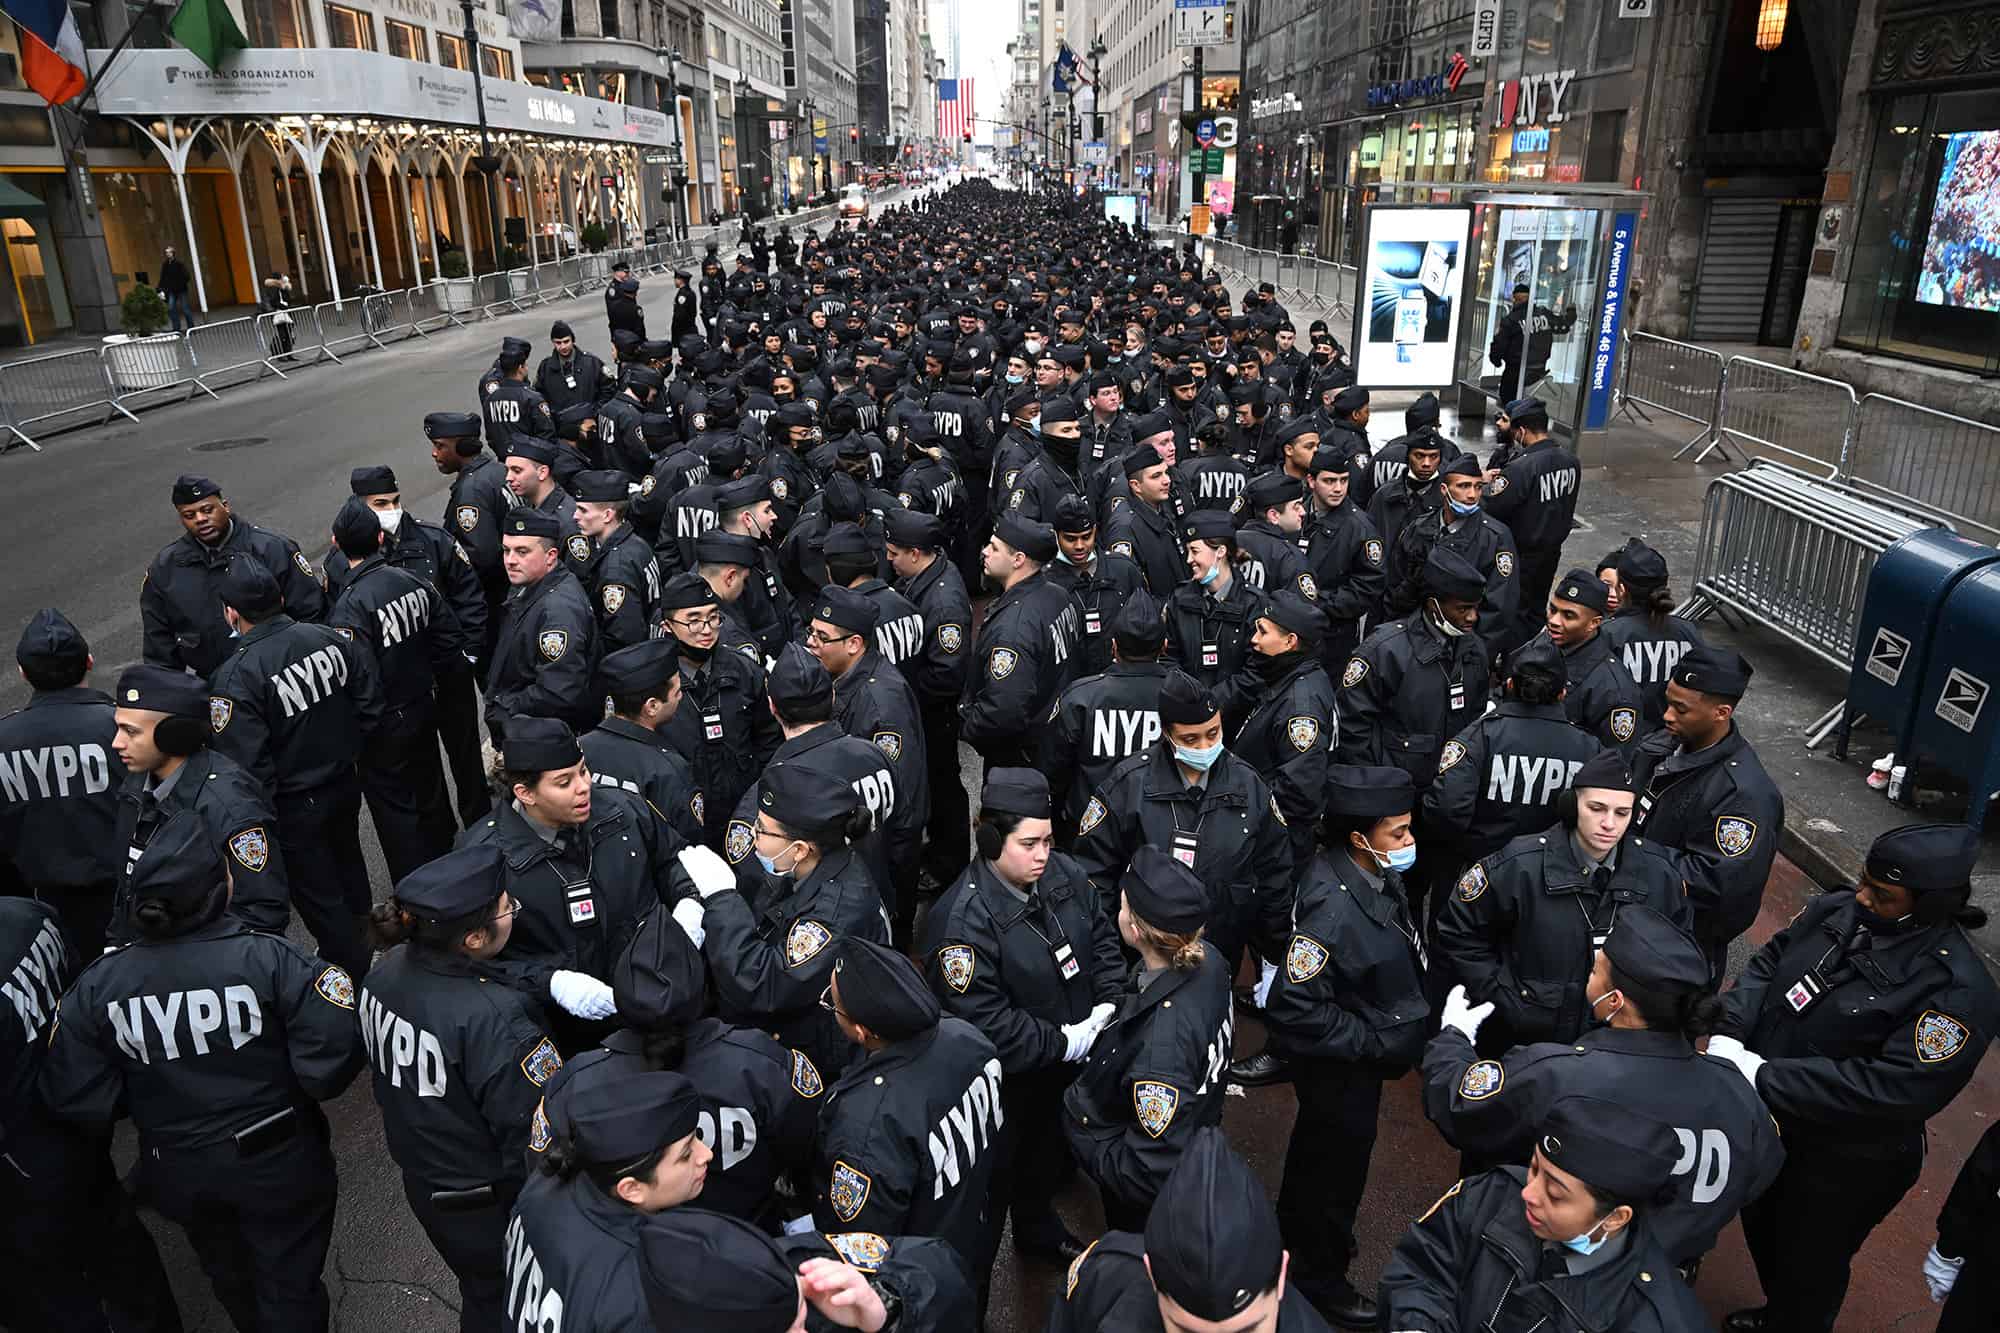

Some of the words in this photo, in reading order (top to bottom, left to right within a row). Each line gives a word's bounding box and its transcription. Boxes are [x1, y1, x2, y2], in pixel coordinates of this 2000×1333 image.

[1477, 9, 1495, 50] GIFTS
[182, 71, 202, 79] THE
[232, 70, 314, 79] ORGANIZATION
[1616, 231, 1626, 239] 5
[1609, 241, 1625, 288] Avenue
[1602, 302, 1616, 333] West
[1606, 290, 1617, 301] &
[1599, 335, 1610, 352] 46
[1593, 353, 1609, 390] Street
[490, 401, 519, 423] NYPD
[1200, 472, 1246, 498] NYPD
[1540, 467, 1576, 502] NYPD
[377, 587, 430, 648] NYPD
[875, 614, 924, 664] NYPD
[271, 644, 349, 719] NYPD
[1093, 708, 1161, 757] NYP
[0, 743, 109, 802] NYPD
[107, 985, 262, 1064] NYPD
[360, 987, 447, 1097] NYPD
[697, 1107, 757, 1171] PD
[928, 1058, 1004, 1201] NYPD
[1670, 1128, 1730, 1203] PD
